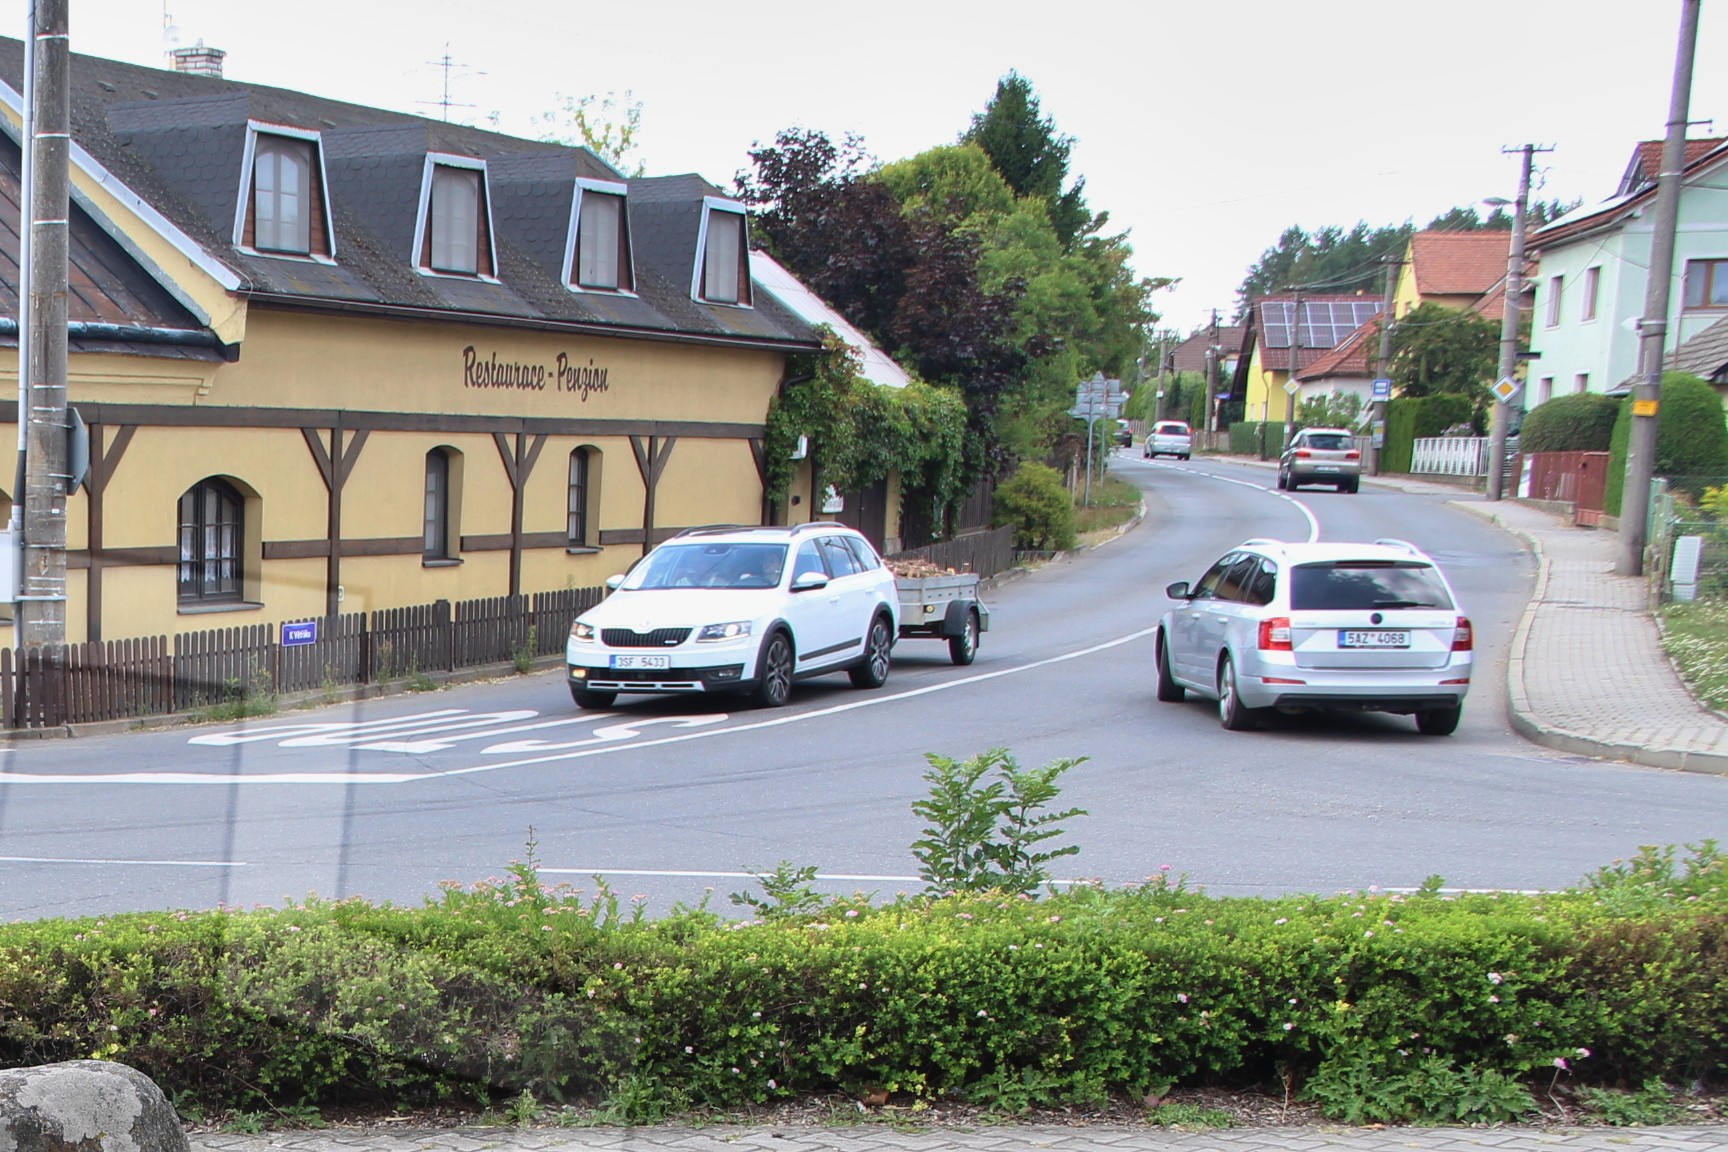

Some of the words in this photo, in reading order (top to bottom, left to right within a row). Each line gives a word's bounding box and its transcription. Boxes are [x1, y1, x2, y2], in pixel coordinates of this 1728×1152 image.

[462, 345, 545, 391] Restaurace
[557, 351, 609, 402] Penzion
[1348, 633, 1369, 644] 5AZ
[1377, 633, 1404, 644] 4068
[618, 657, 634, 667] 3SF
[641, 657, 664, 667] 5433
